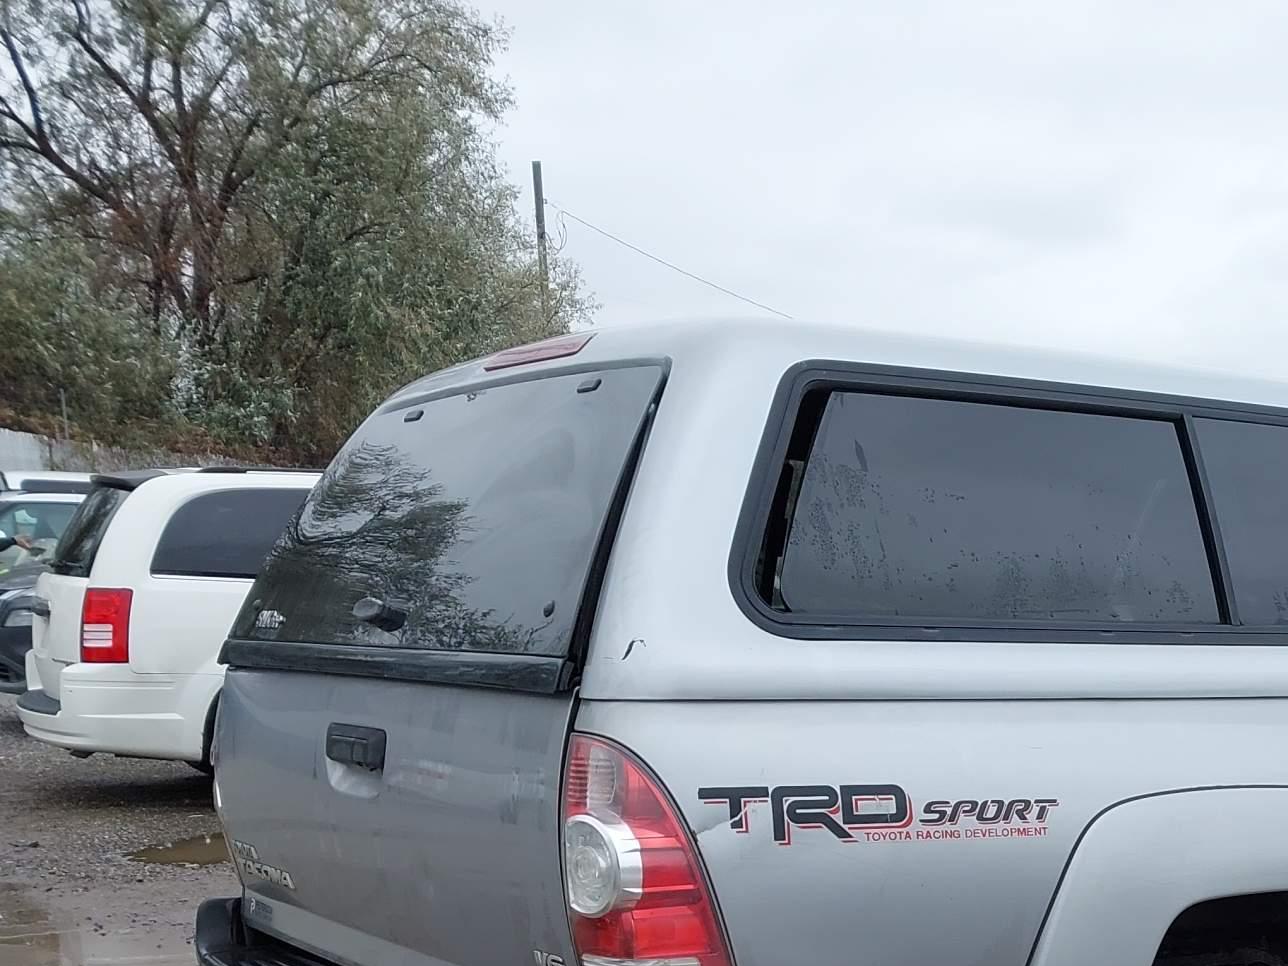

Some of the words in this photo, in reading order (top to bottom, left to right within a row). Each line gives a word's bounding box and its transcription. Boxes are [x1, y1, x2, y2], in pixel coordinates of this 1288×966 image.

[698, 783, 914, 846] TRD
[919, 797, 1060, 826] SPORT
[864, 830, 913, 842] TOYOTA
[916, 828, 962, 841] RACING
[964, 826, 1049, 839] DEVELOPMENT
